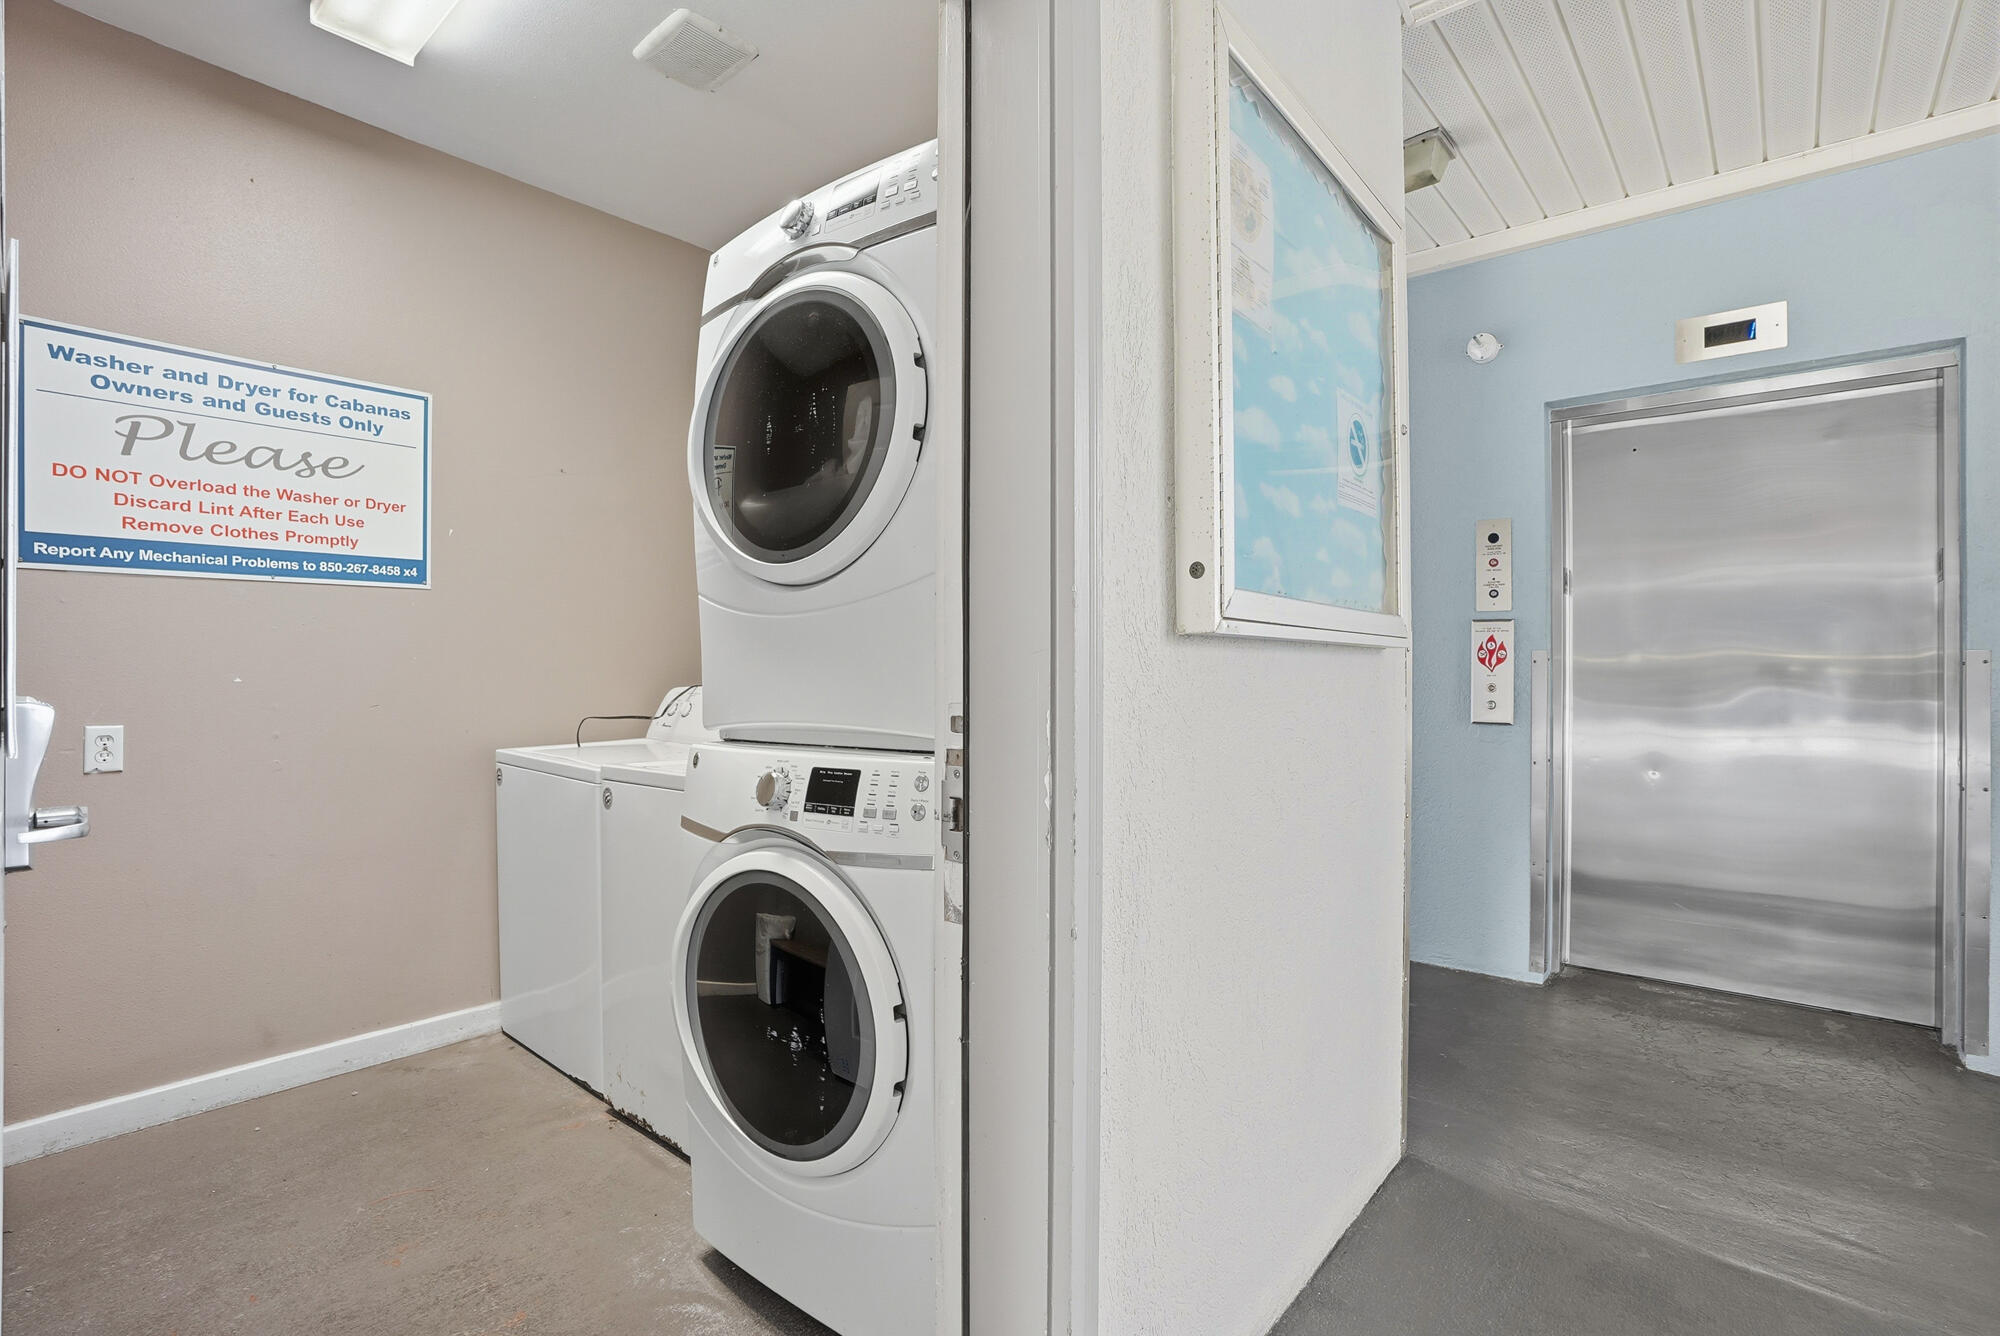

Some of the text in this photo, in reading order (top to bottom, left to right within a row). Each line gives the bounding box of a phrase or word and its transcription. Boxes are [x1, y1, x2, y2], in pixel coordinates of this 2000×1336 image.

[47, 343, 411, 420] Washer and Dryer for Cabanas
[91, 375, 384, 436] Owners and Guests Only
[115, 415, 365, 479] Please
[52, 462, 406, 513] DO NOT Overload the Washer or Dryer
[114, 493, 365, 528] Discard Lint After Each Use
[122, 516, 359, 549] Remove Clothes Promptly
[33, 542, 418, 577] Report Any Mechanical Problems to 850-267-8458 x4
